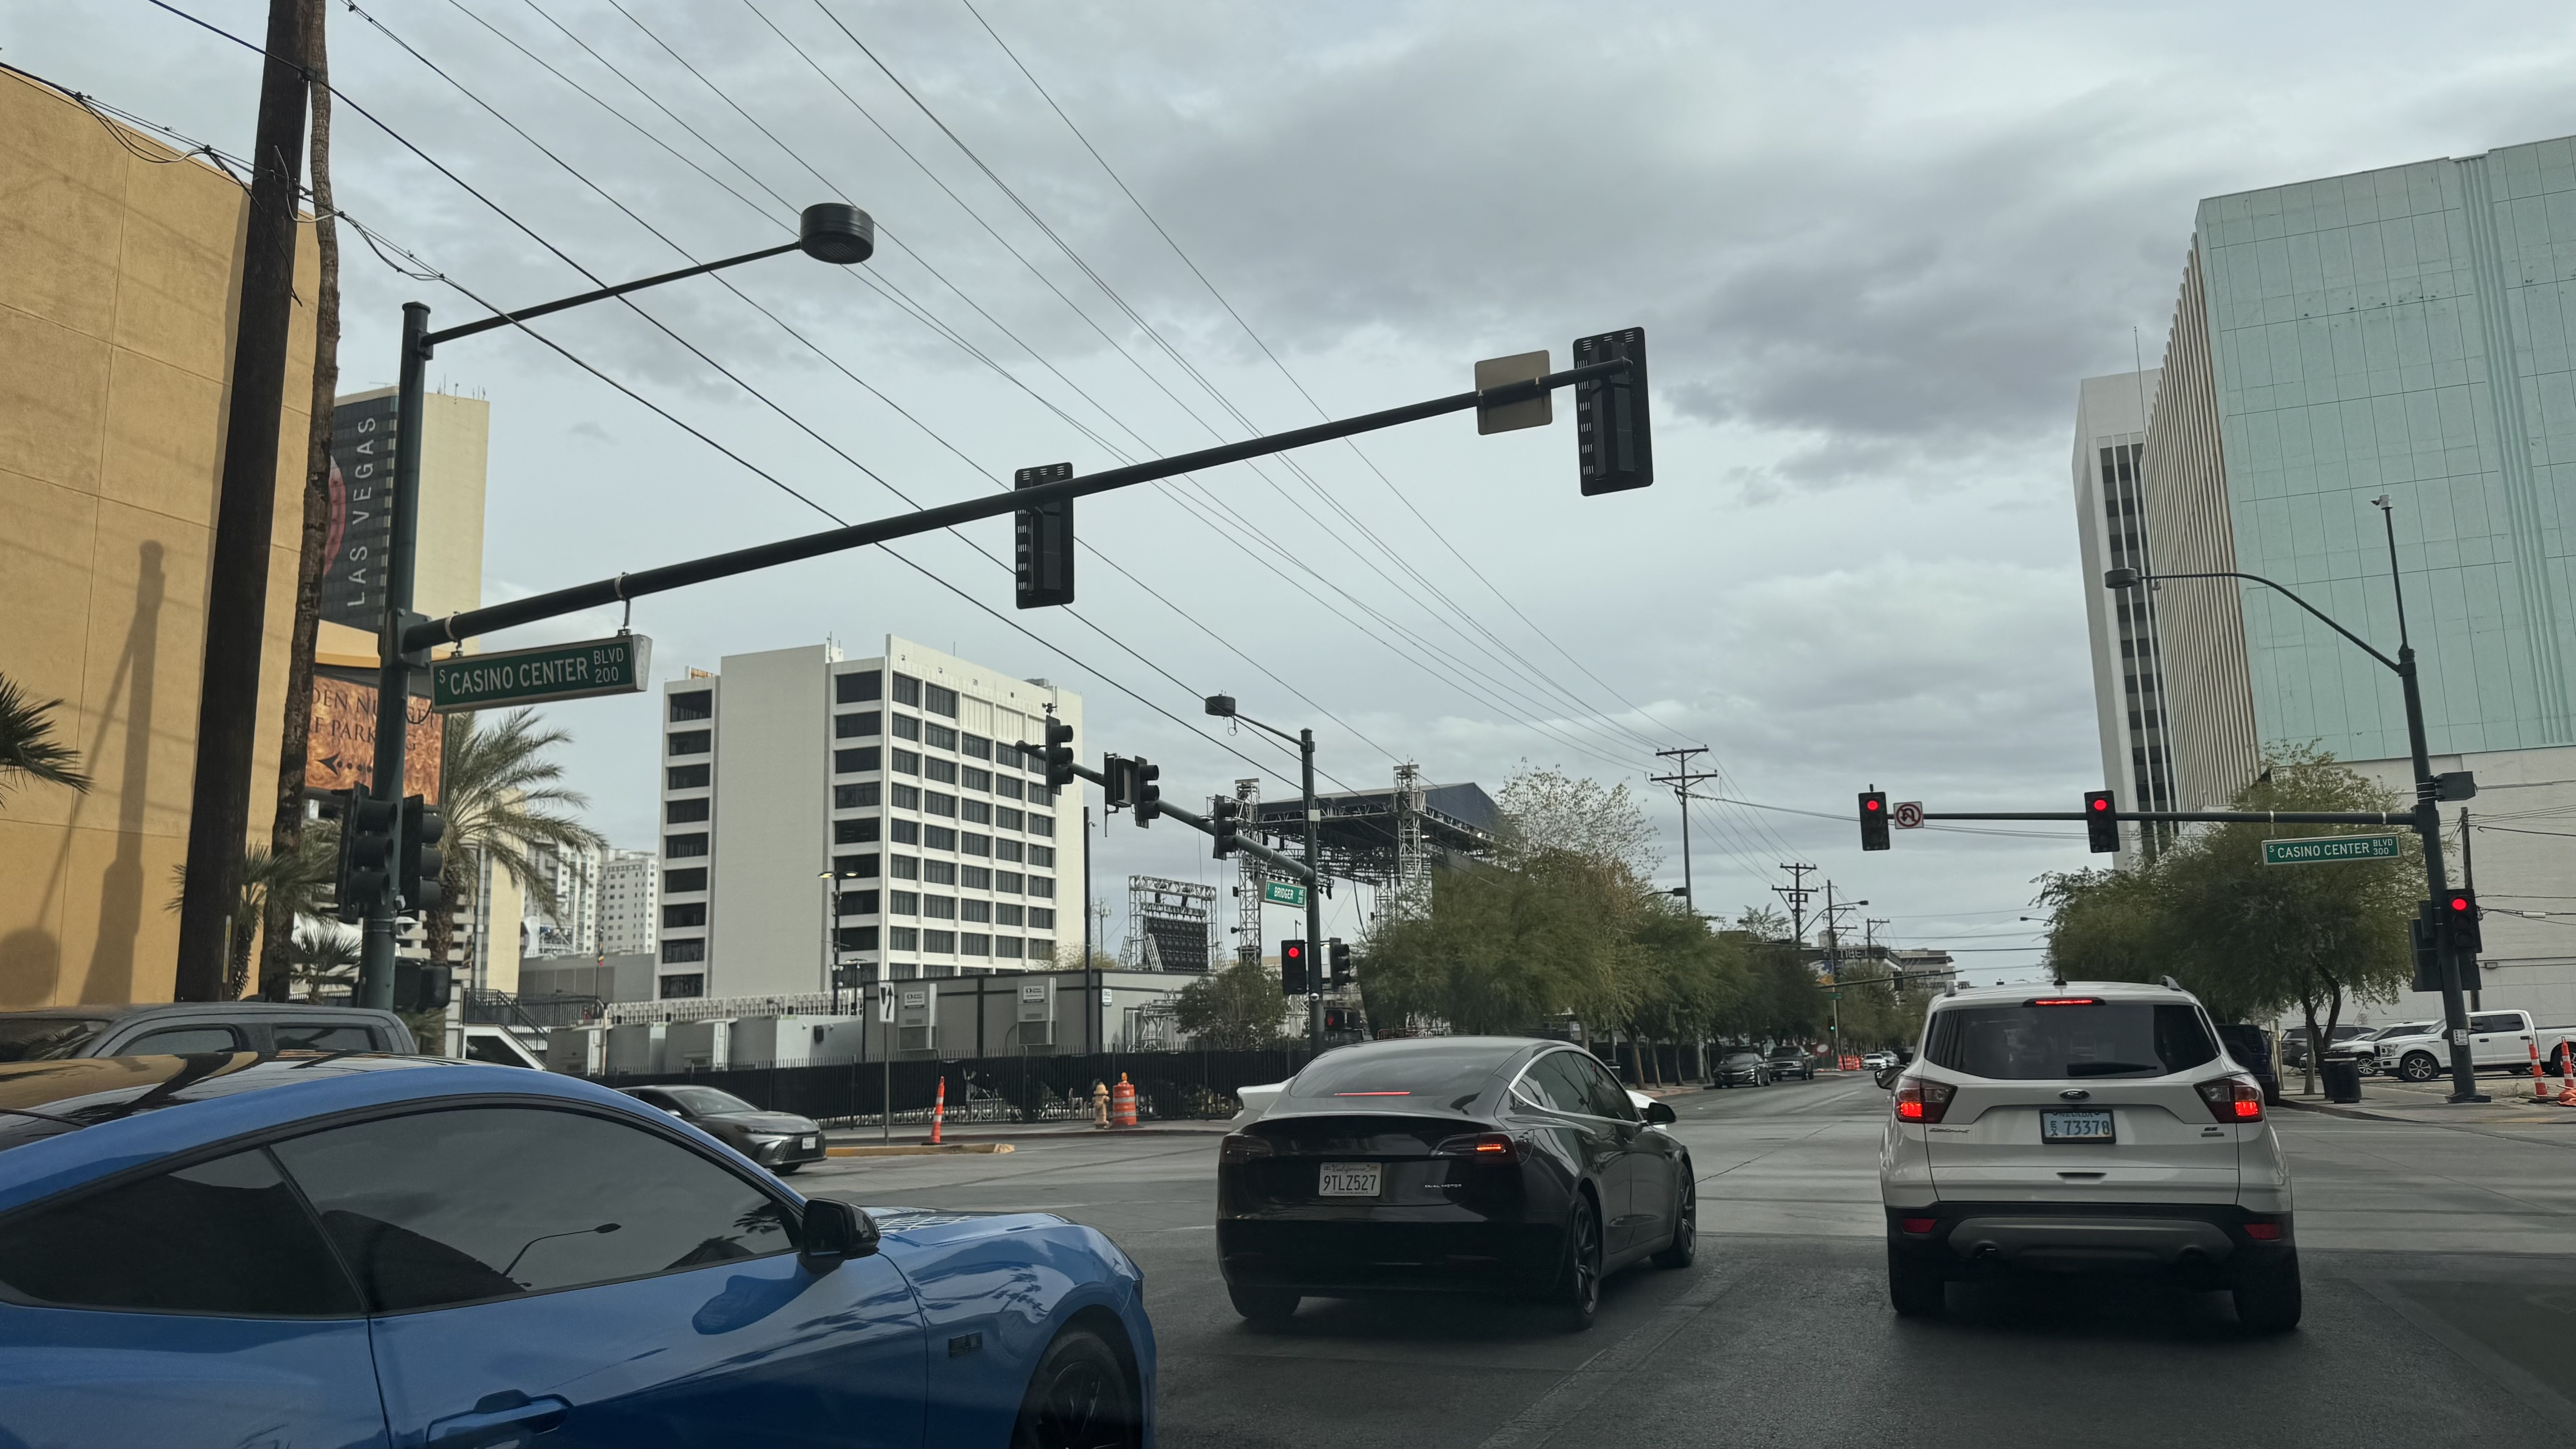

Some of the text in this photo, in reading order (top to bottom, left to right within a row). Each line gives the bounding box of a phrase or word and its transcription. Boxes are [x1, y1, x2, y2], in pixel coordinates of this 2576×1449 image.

[347, 417, 376, 607] LAS VEGAS
[439, 669, 446, 684] S
[451, 666, 514, 695] CASINO
[519, 657, 589, 687] CENTER
[593, 647, 624, 665] BLVD
[595, 667, 619, 684] 200
[313, 687, 348, 710] DEN
[2277, 845, 2320, 858] CASINO
[2324, 842, 2369, 856] CENTER
[2373, 838, 2393, 847] BLVD
[2373, 847, 2389, 855] 300
[1274, 887, 1293, 900] BRIDGER
[2063, 1120, 2110, 1135] 73378
[1332, 1164, 1369, 1173] California
[1323, 1174, 1377, 1191] 9TLZ527
